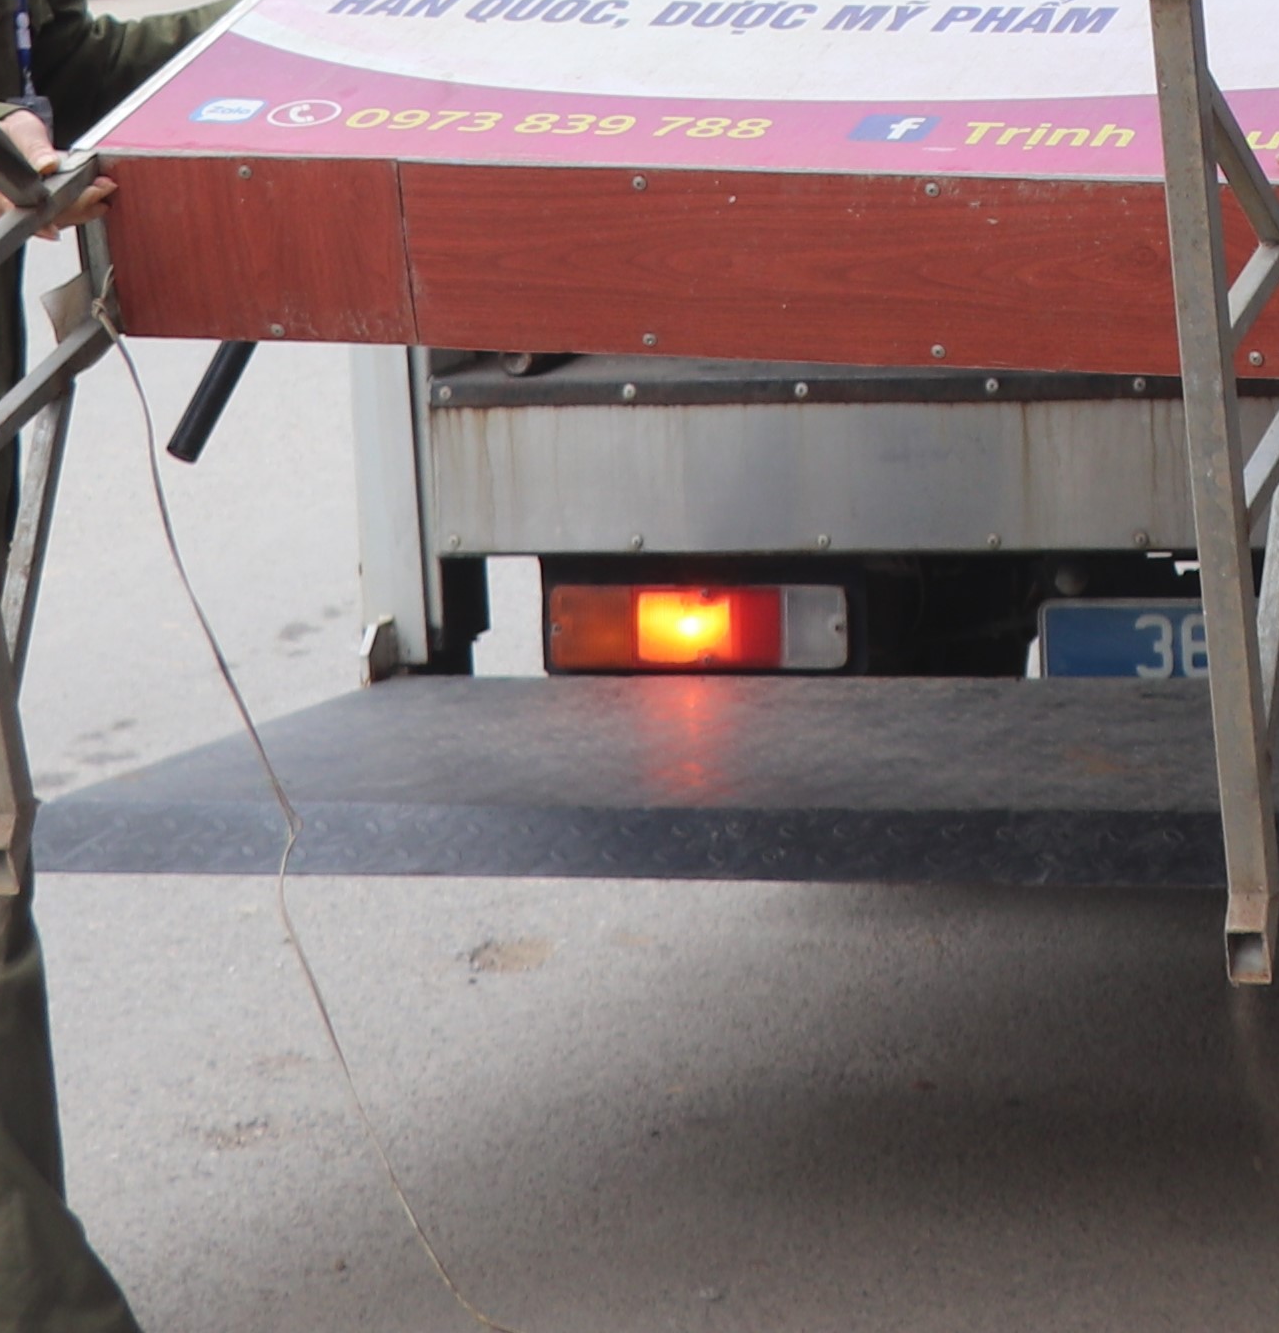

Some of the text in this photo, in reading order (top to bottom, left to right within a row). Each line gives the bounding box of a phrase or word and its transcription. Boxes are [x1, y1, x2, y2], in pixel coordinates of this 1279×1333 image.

[648, 0, 820, 36] DƯỢC
[822, 0, 930, 32] MỸ
[344, 107, 503, 132] 0973
[513, 112, 637, 136] 839
[652, 116, 773, 139] 788
[963, 120, 1136, 151] Trịnh
